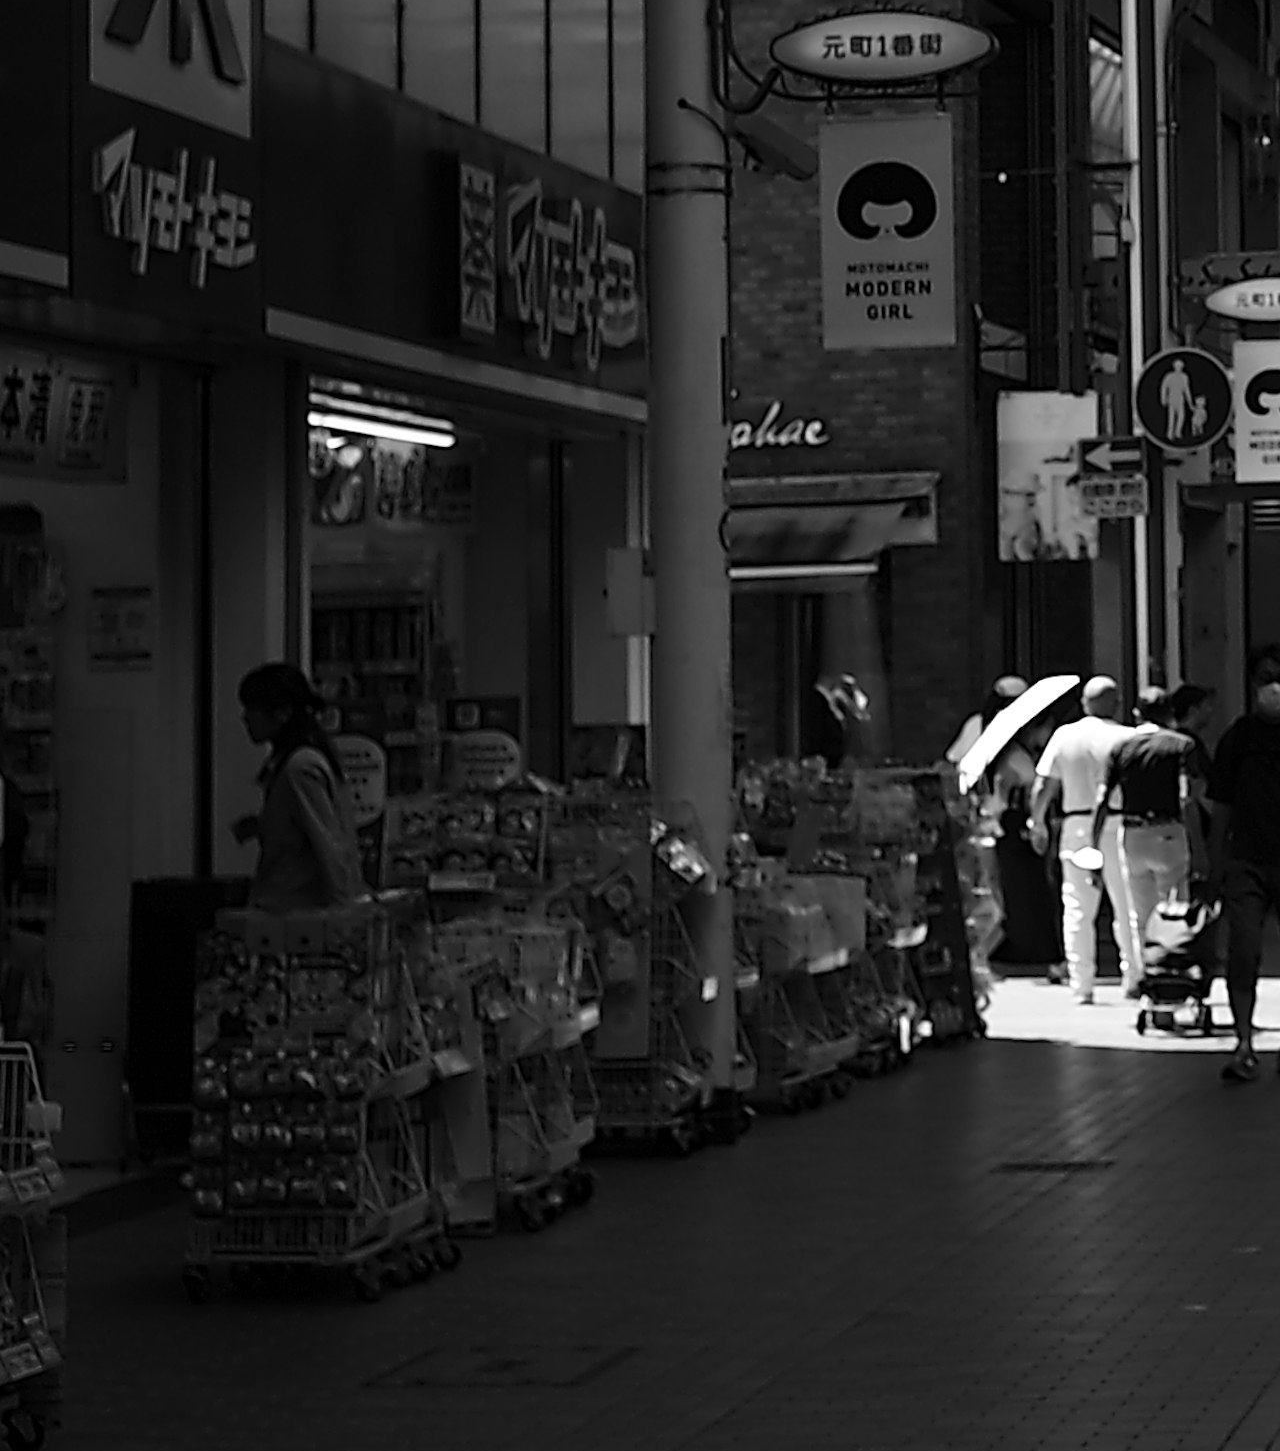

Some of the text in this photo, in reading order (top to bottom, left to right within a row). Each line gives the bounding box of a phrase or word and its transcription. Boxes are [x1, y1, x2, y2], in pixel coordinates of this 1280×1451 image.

[823, 33, 942, 59] 元町1番街
[847, 261, 930, 274] MOTOMACHI
[845, 279, 932, 298] MODERN
[866, 303, 913, 321] GIRL
